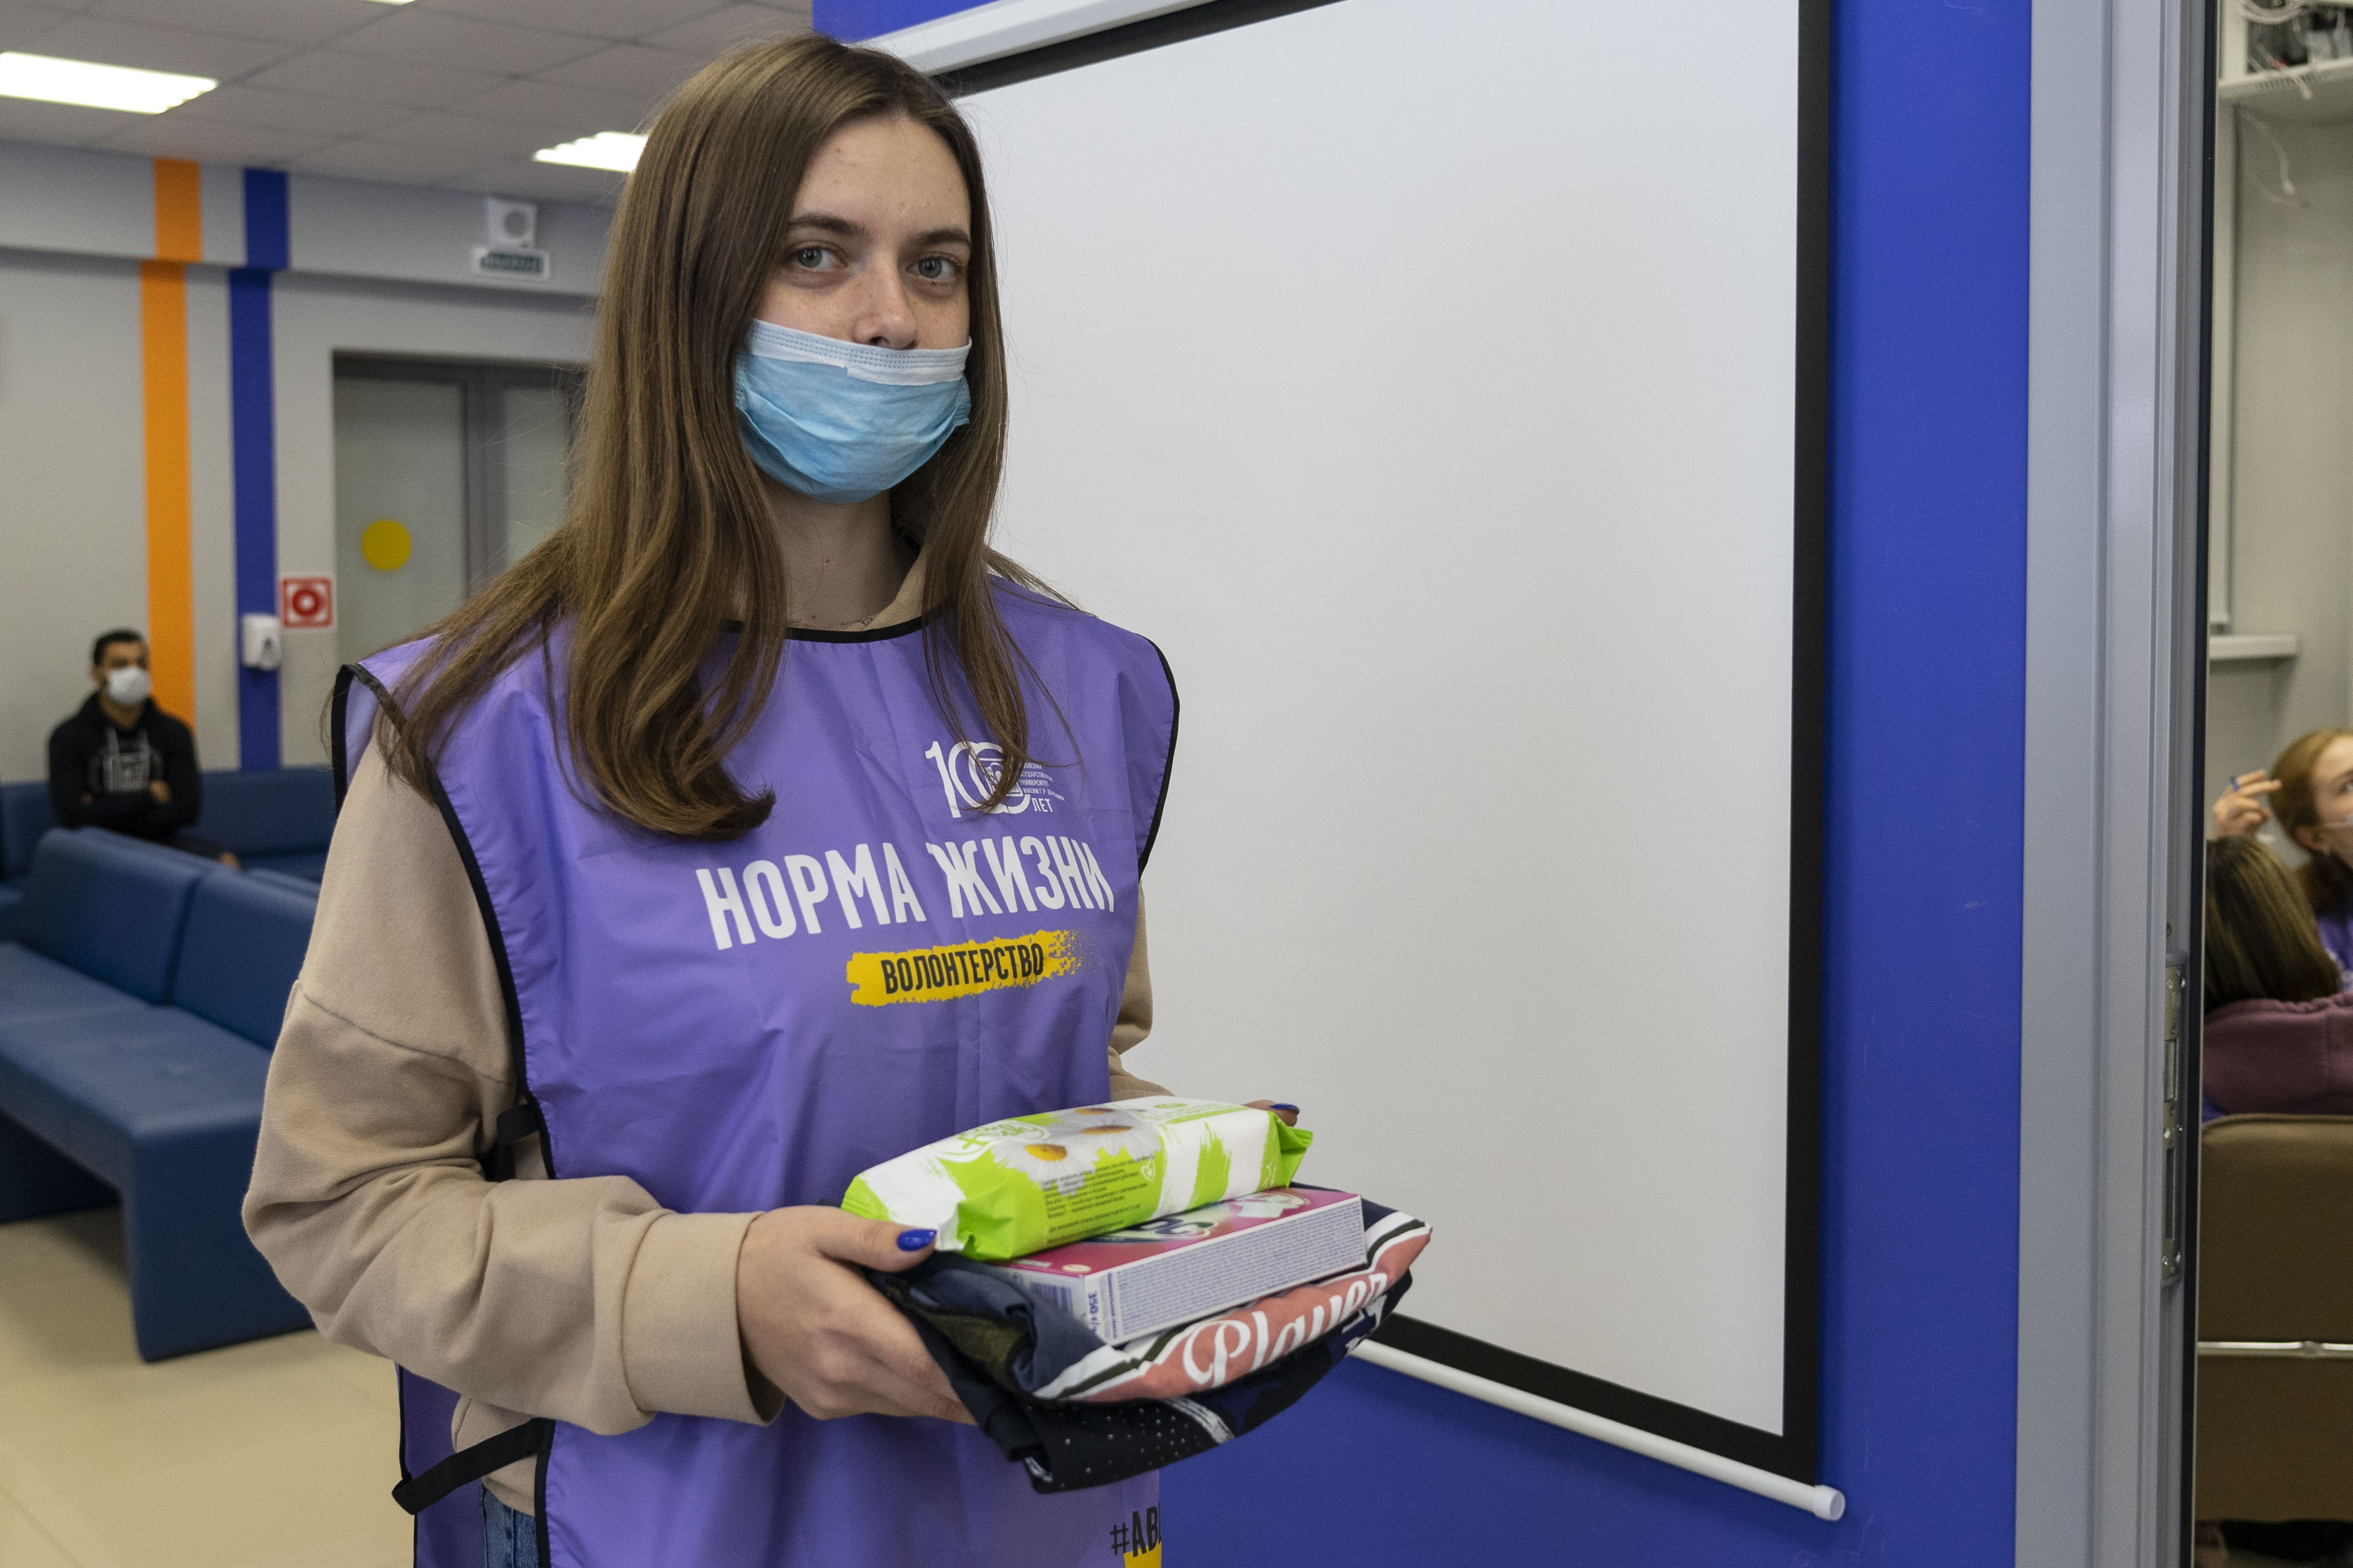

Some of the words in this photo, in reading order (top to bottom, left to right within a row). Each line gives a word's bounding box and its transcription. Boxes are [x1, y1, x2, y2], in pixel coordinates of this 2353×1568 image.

[1031, 797, 1053, 813] ЛЕТ
[695, 841, 926, 951] НОРМА
[925, 835, 1115, 919] ЖИЗНИ
[880, 942, 1044, 995] ВОЛОНТЕРСТВО
[1110, 1501, 1162, 1558] #АВ
